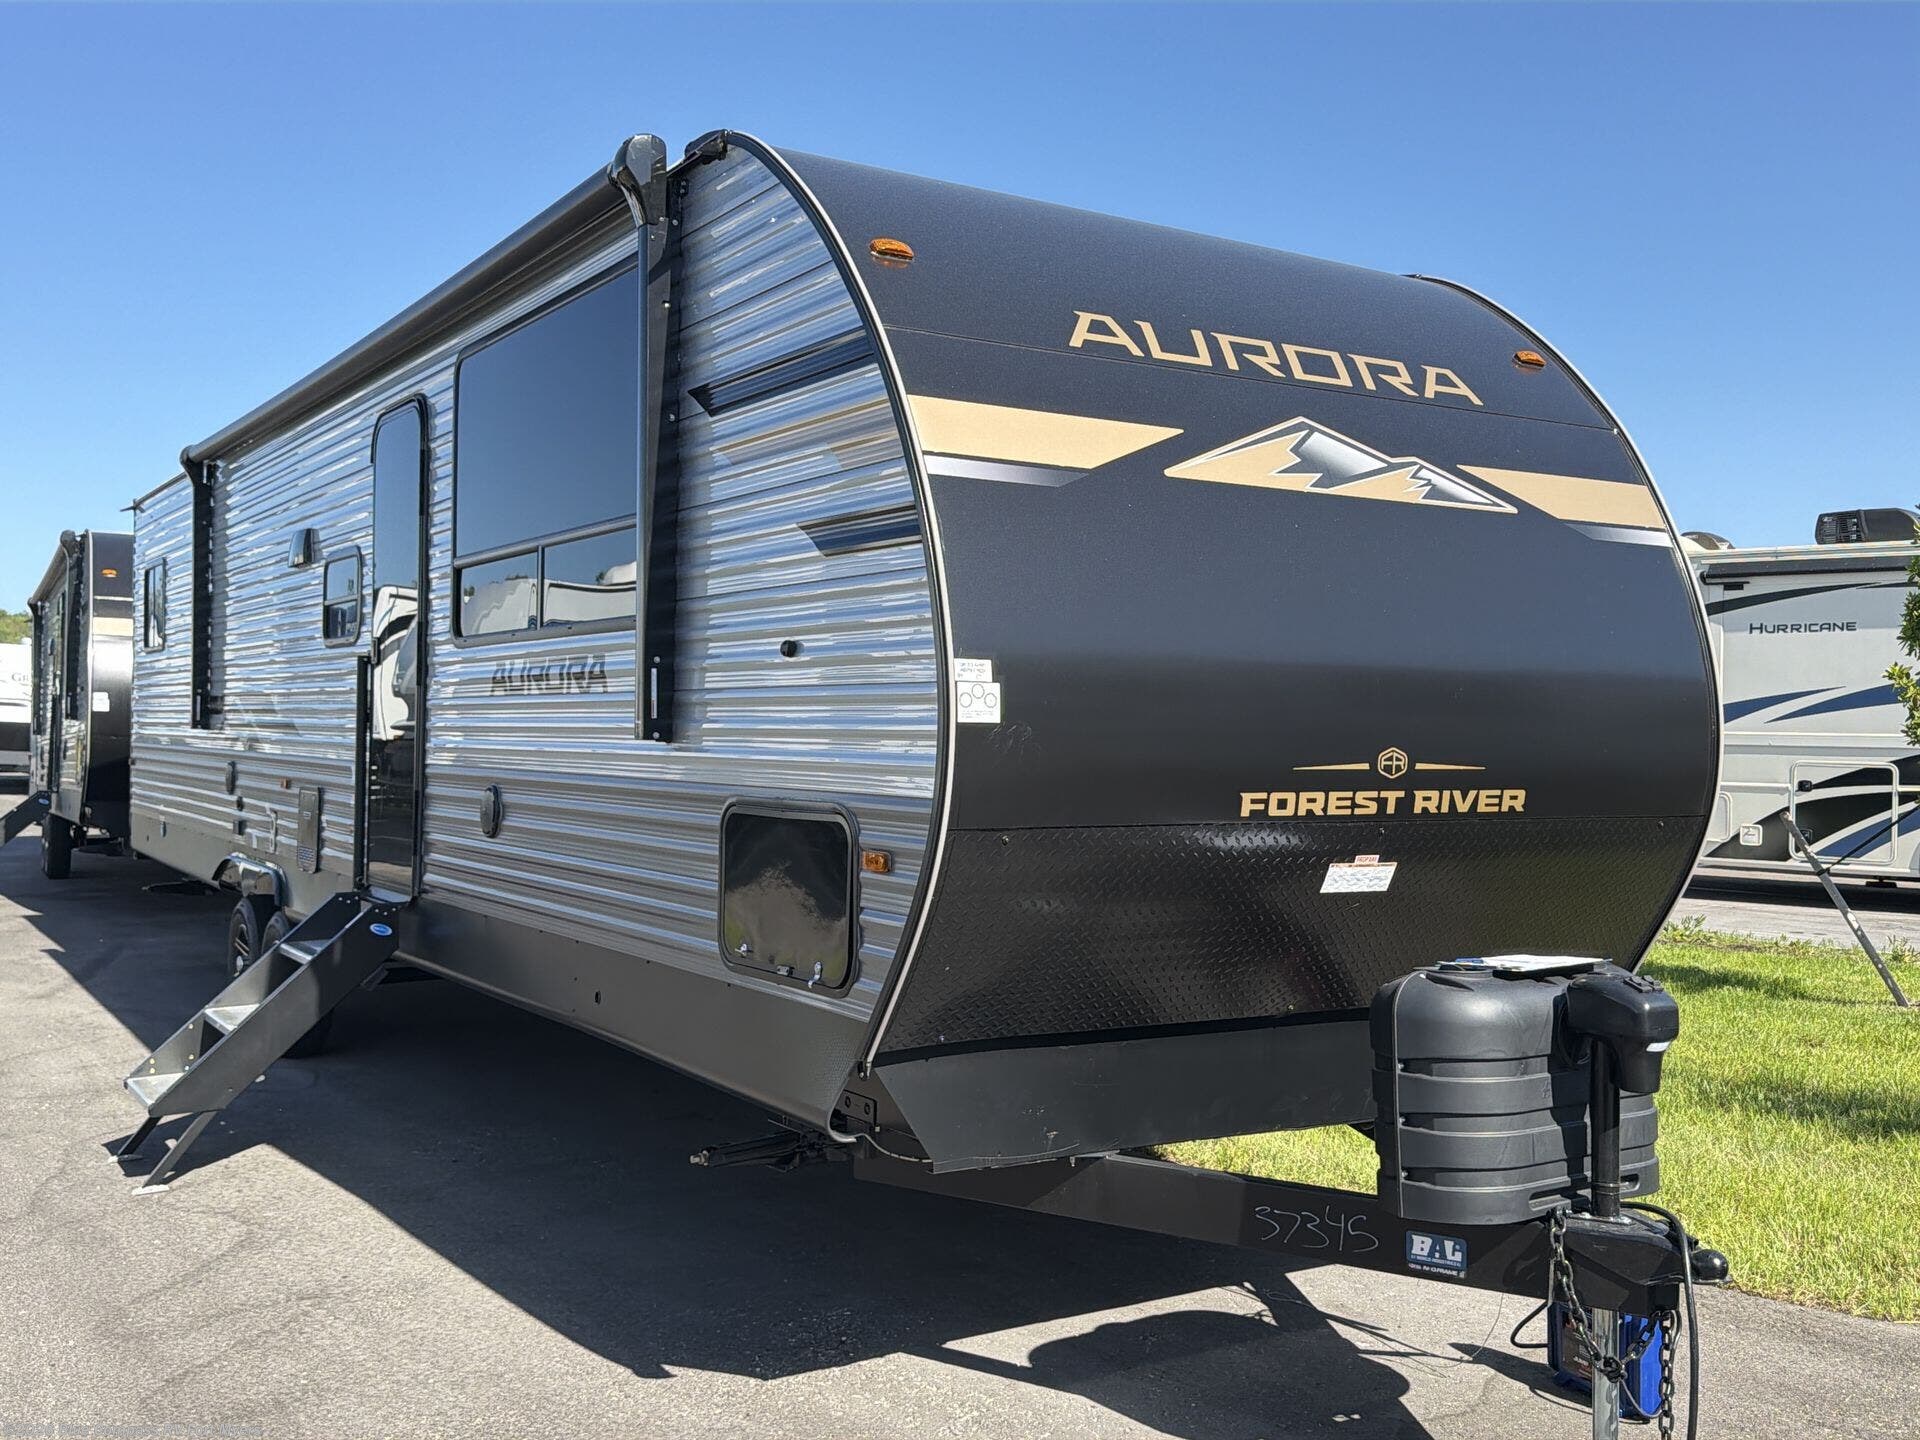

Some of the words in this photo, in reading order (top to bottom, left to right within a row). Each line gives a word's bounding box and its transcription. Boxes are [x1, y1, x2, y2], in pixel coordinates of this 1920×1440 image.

[1069, 310, 1484, 406] AURORA
[1749, 621, 1857, 634] HURRICANE
[490, 653, 608, 696] AURORA
[1239, 790, 1405, 817] FOREST
[1413, 789, 1526, 814] RIVER
